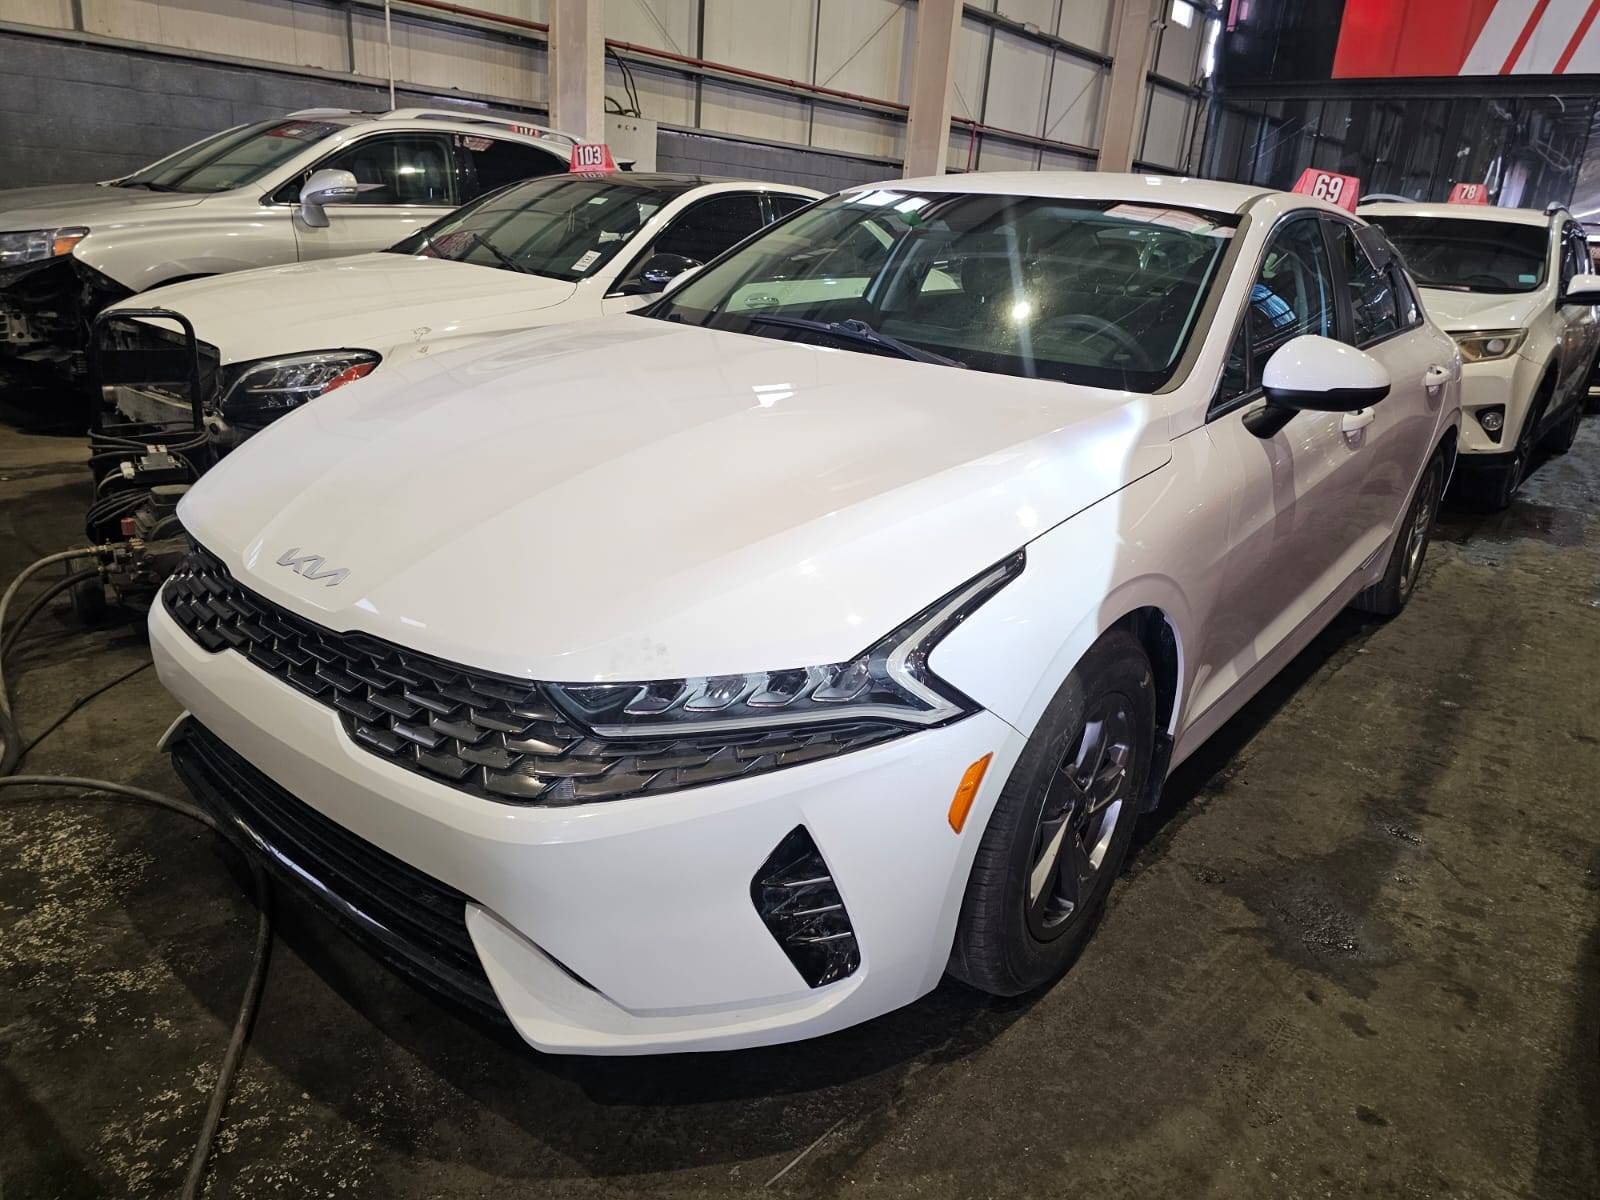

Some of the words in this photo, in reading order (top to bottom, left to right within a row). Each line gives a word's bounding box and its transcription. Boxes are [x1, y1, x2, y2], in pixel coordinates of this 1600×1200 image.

[578, 145, 602, 166] 103
[1312, 174, 1344, 204] 69
[1460, 184, 1477, 200] 78
[276, 547, 352, 587] KIA
